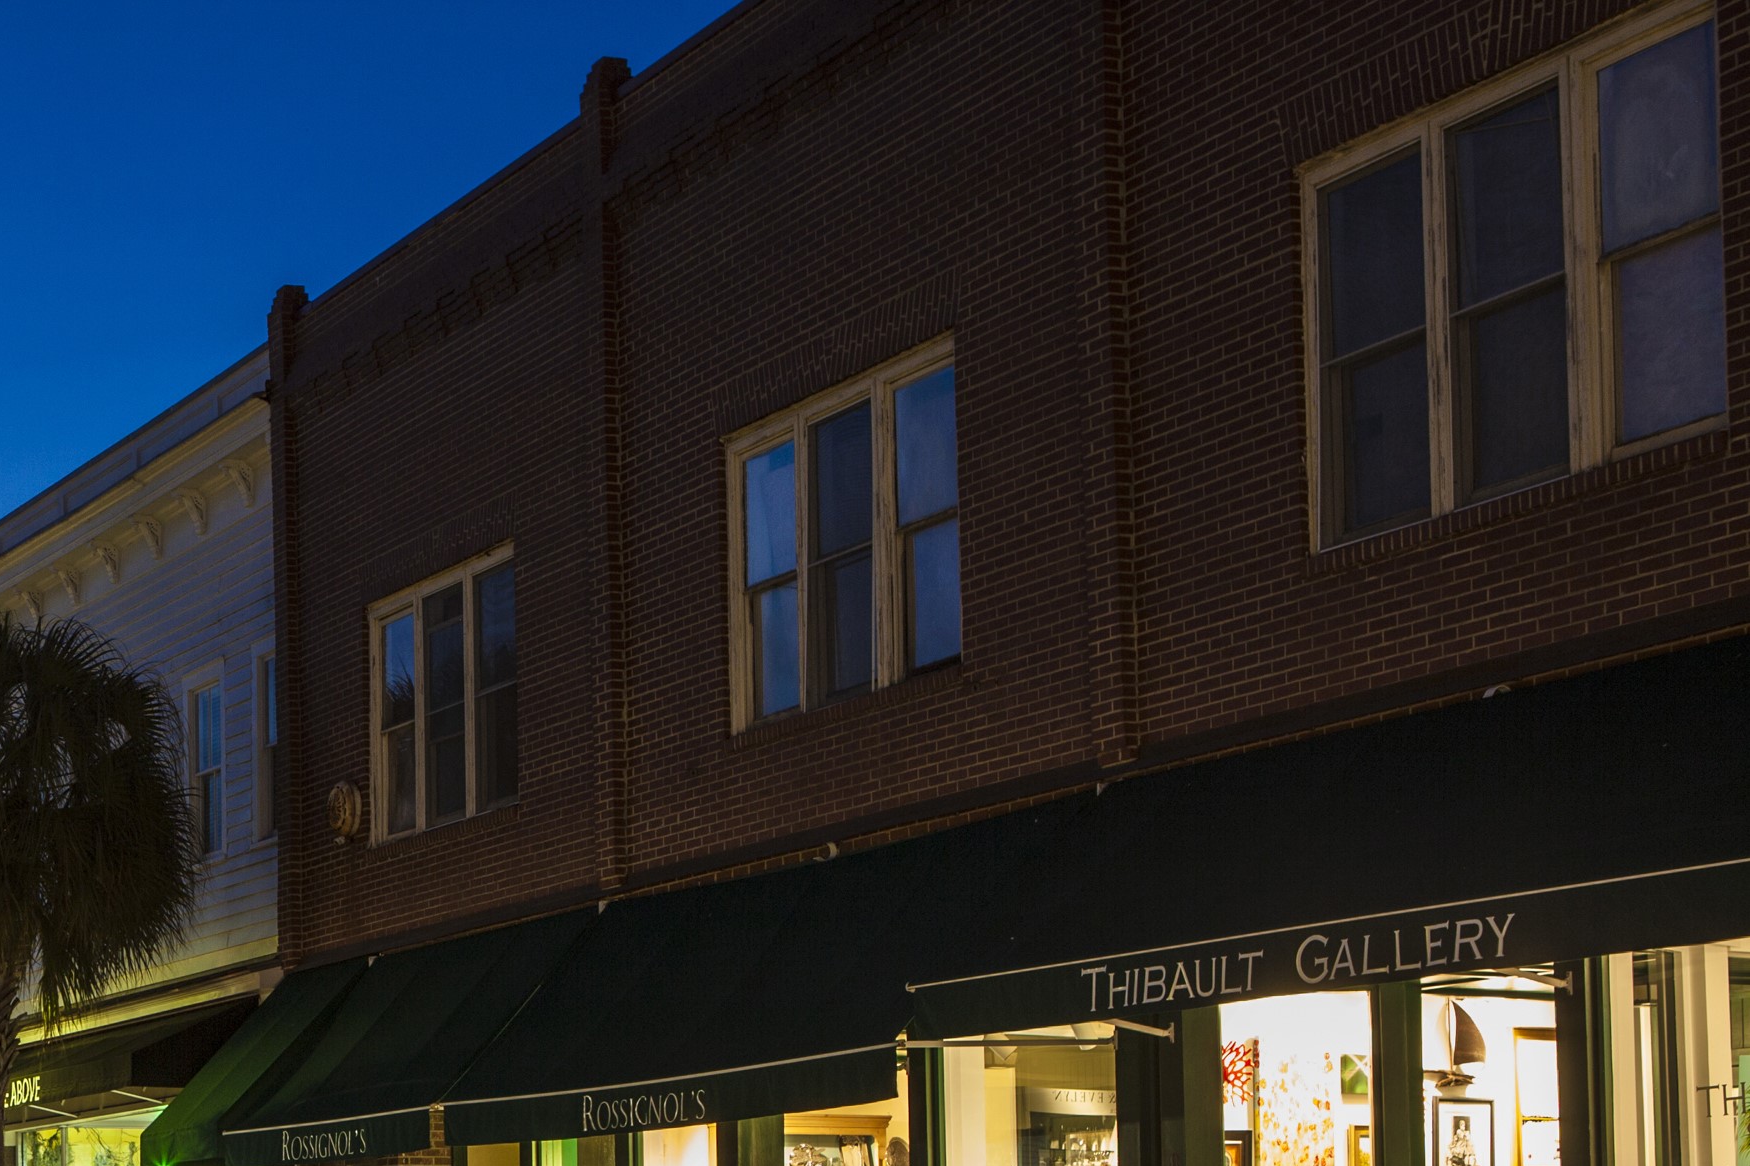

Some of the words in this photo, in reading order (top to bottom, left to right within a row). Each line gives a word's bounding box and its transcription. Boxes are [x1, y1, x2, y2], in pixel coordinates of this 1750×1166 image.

[1081, 949, 1263, 1011] THIBAULT
[1296, 913, 1515, 985] GALLERY
[10, 1076, 40, 1106] ABOVE
[583, 1089, 705, 1131] ROSSIGNOL'S
[282, 1129, 367, 1161] ROSSIGNOL'S
